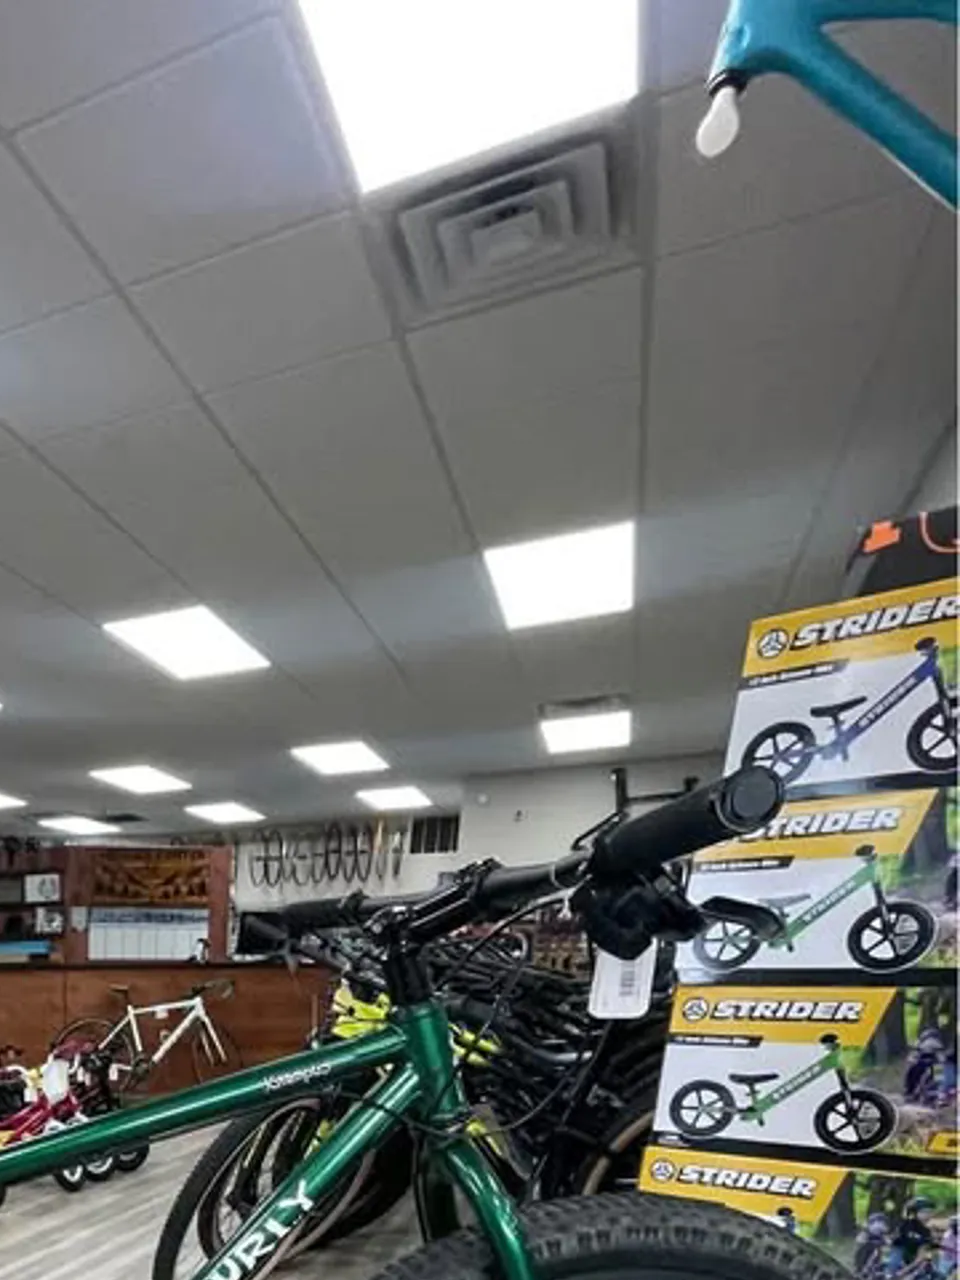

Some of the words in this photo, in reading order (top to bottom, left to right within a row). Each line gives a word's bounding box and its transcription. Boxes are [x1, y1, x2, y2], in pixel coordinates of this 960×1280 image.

[791, 596, 958, 649] STRIDER
[710, 1000, 864, 1021] STRIDER
[679, 1165, 817, 1197] STRIDER
